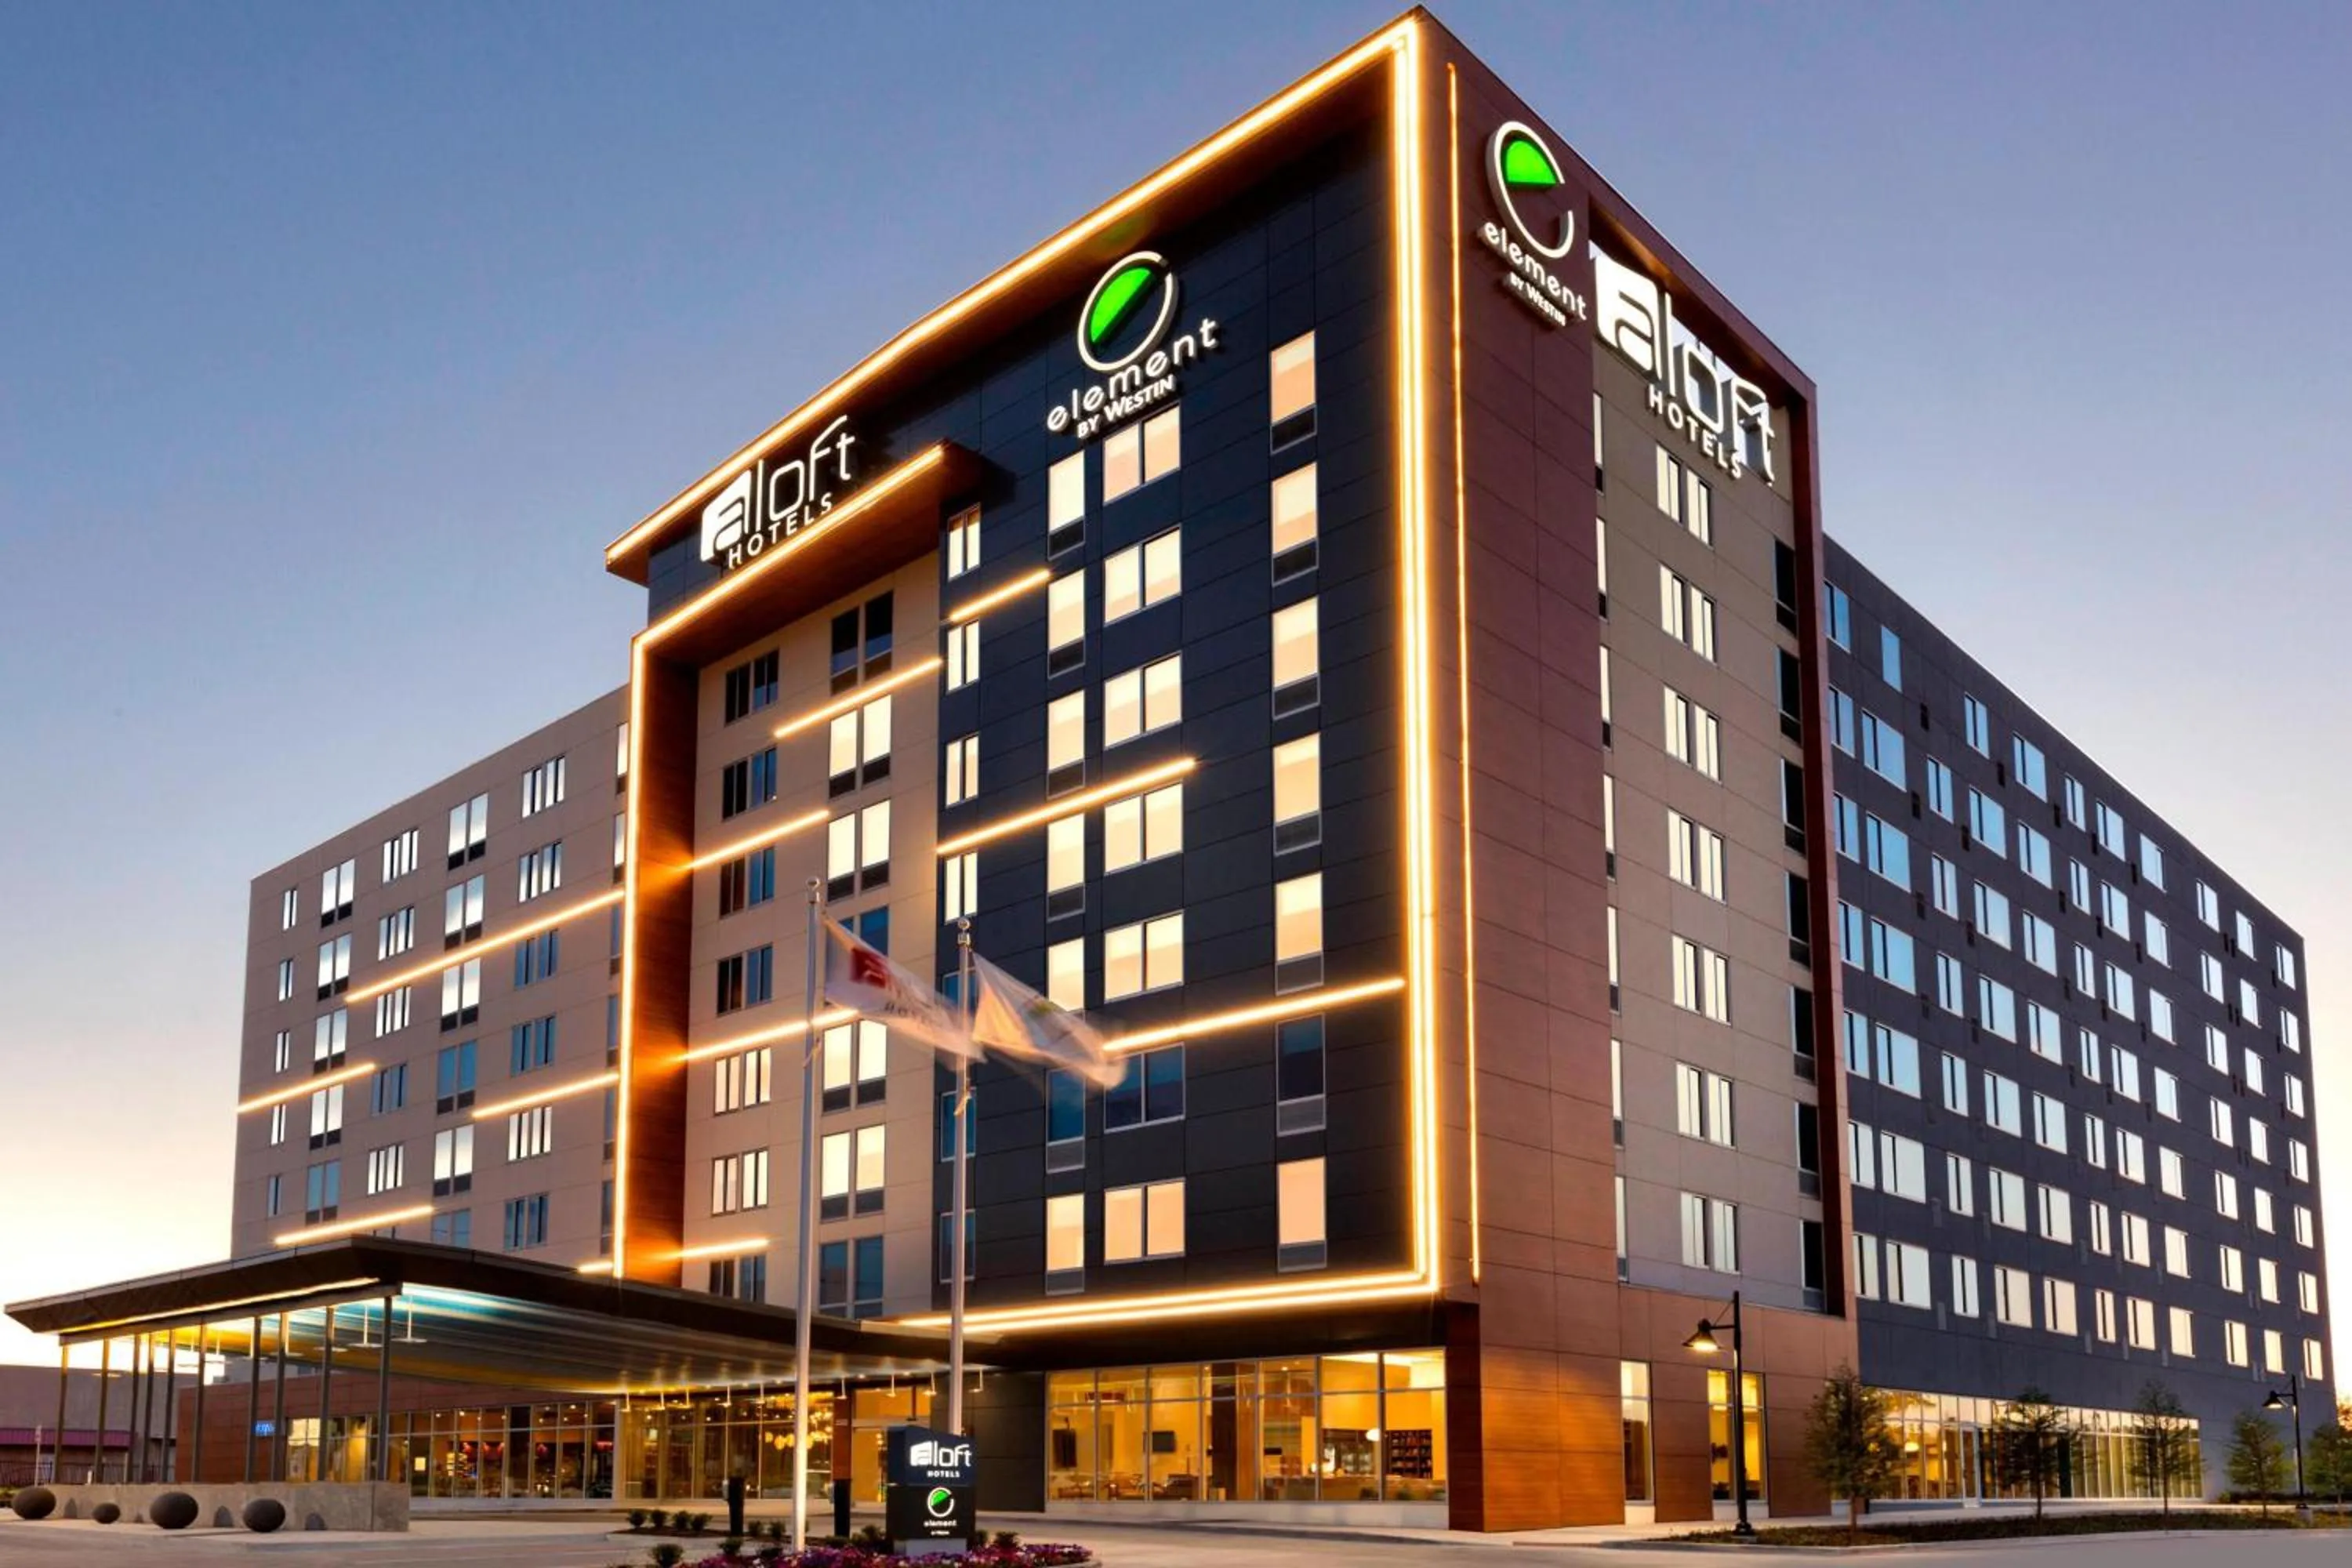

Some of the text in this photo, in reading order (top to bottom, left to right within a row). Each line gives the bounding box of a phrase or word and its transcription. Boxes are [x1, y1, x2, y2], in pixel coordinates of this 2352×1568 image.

[1484, 222, 1587, 321] element
[1047, 318, 1217, 431] element
[1077, 374, 1174, 438] BY WESTIN
[1649, 383, 1742, 479] HOTELS
[700, 414, 855, 562] aloft
[728, 492, 833, 569] HOTELS
[909, 1440, 972, 1468] aloft
